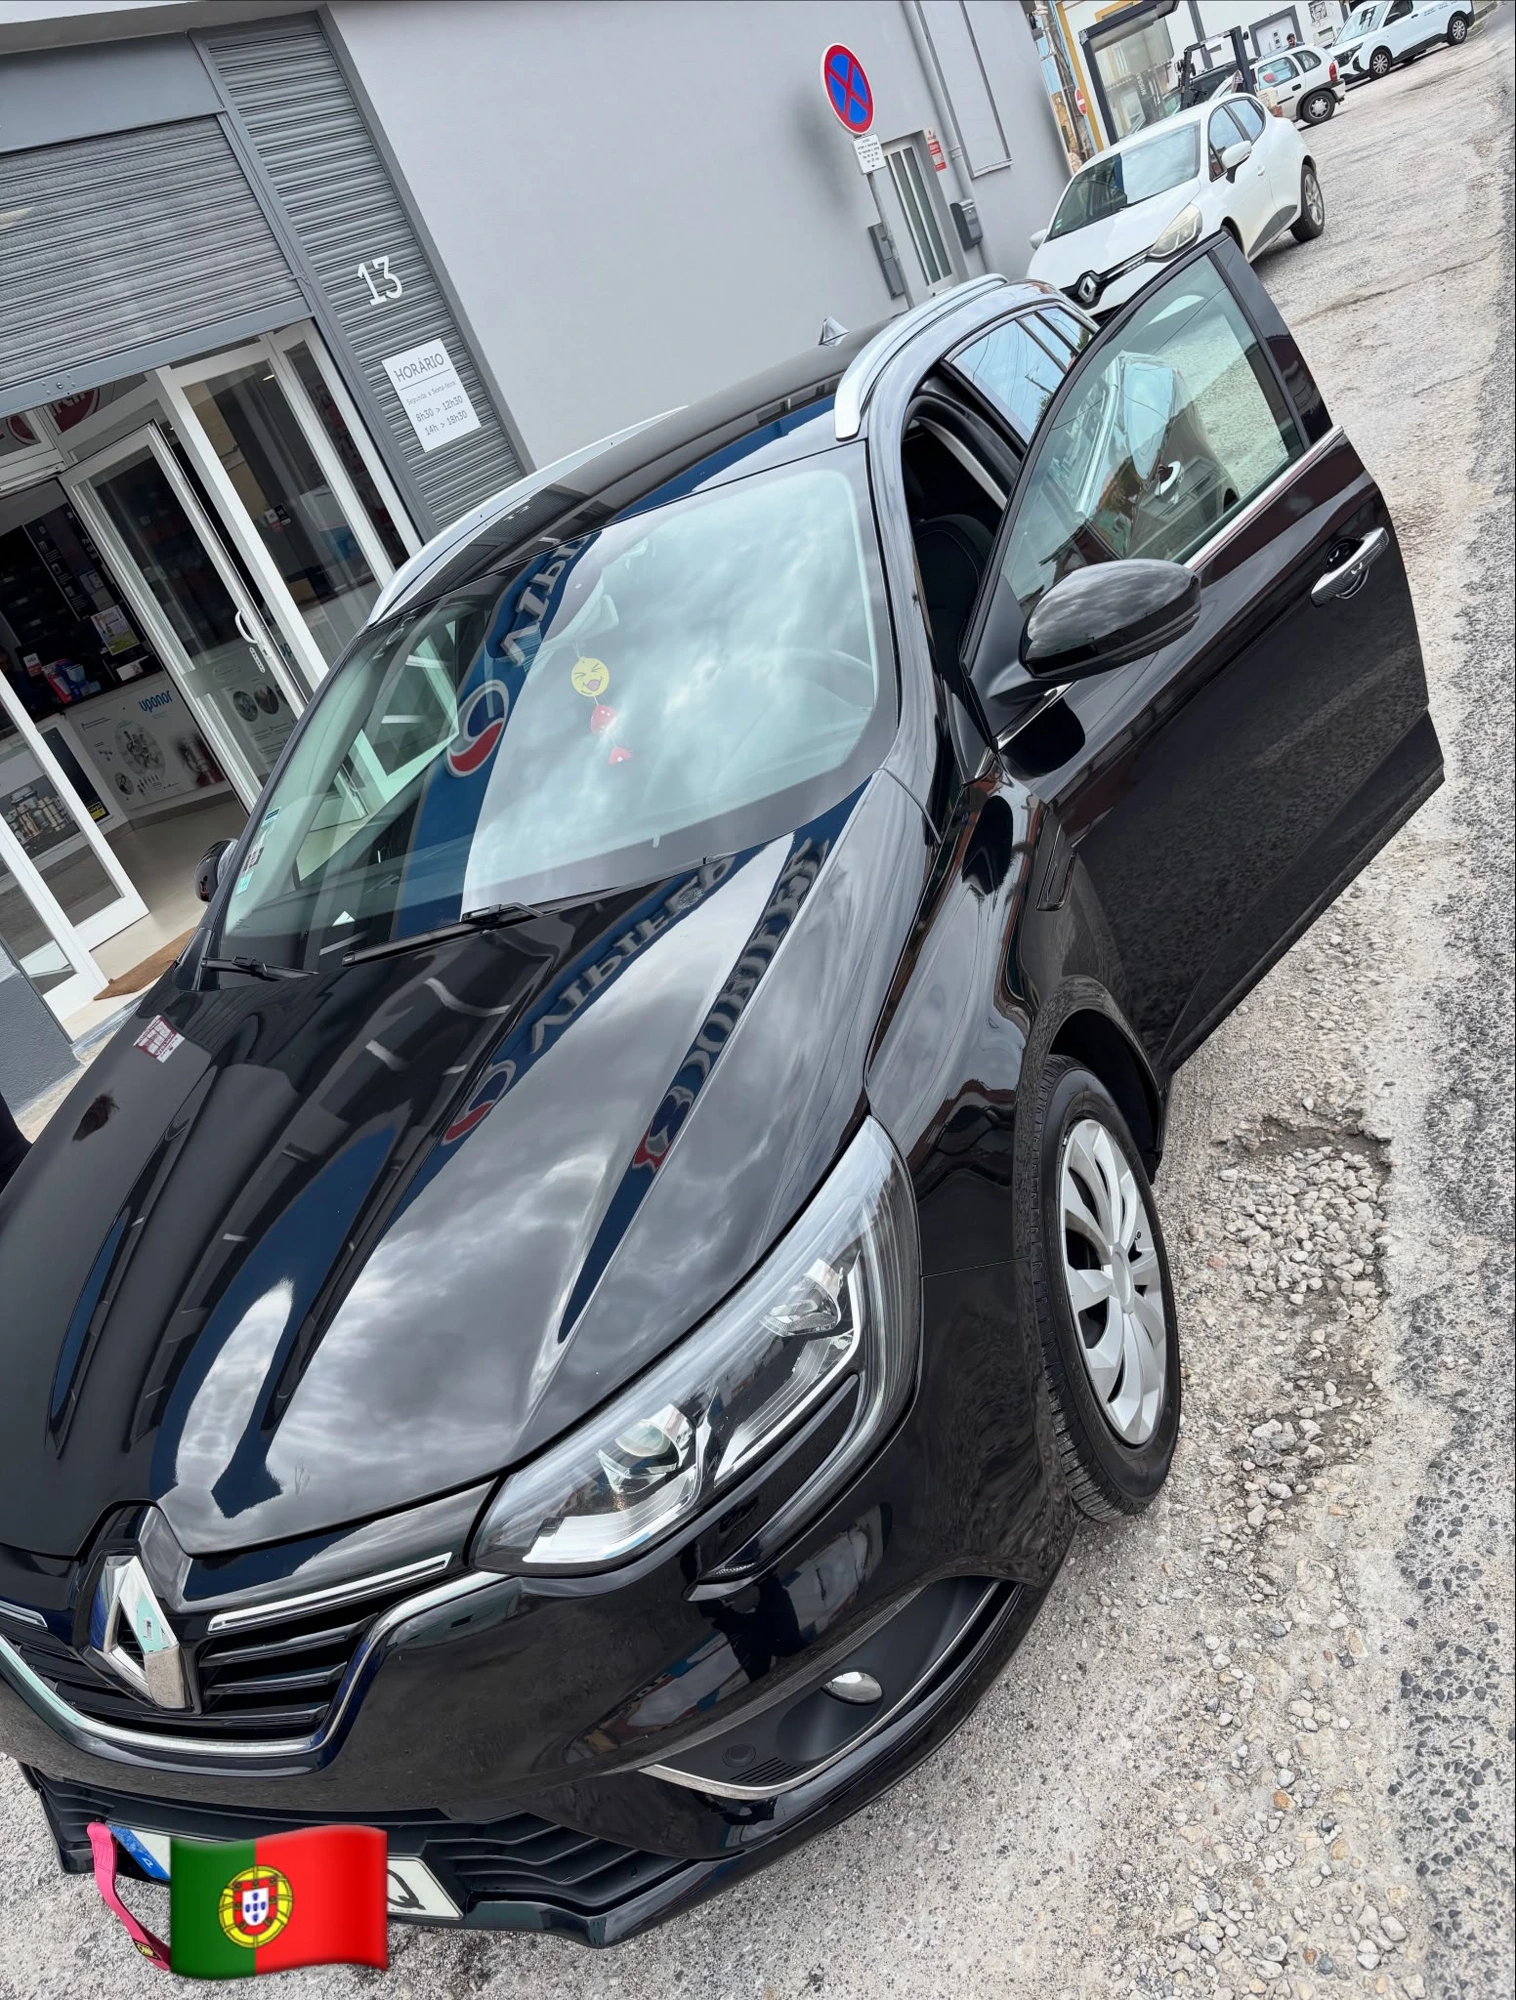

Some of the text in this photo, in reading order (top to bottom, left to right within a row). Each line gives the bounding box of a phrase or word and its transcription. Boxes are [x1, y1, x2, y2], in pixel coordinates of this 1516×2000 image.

[357, 255, 403, 306] 13
[393, 353, 445, 382] HORÁRIO
[415, 408, 434, 422] 8h30
[442, 395, 464, 411] 12h30
[425, 424, 440, 436] 14h
[446, 410, 468, 426] 18h30
[138, 690, 173, 713] uponor
[141, 1856, 153, 1869] P
